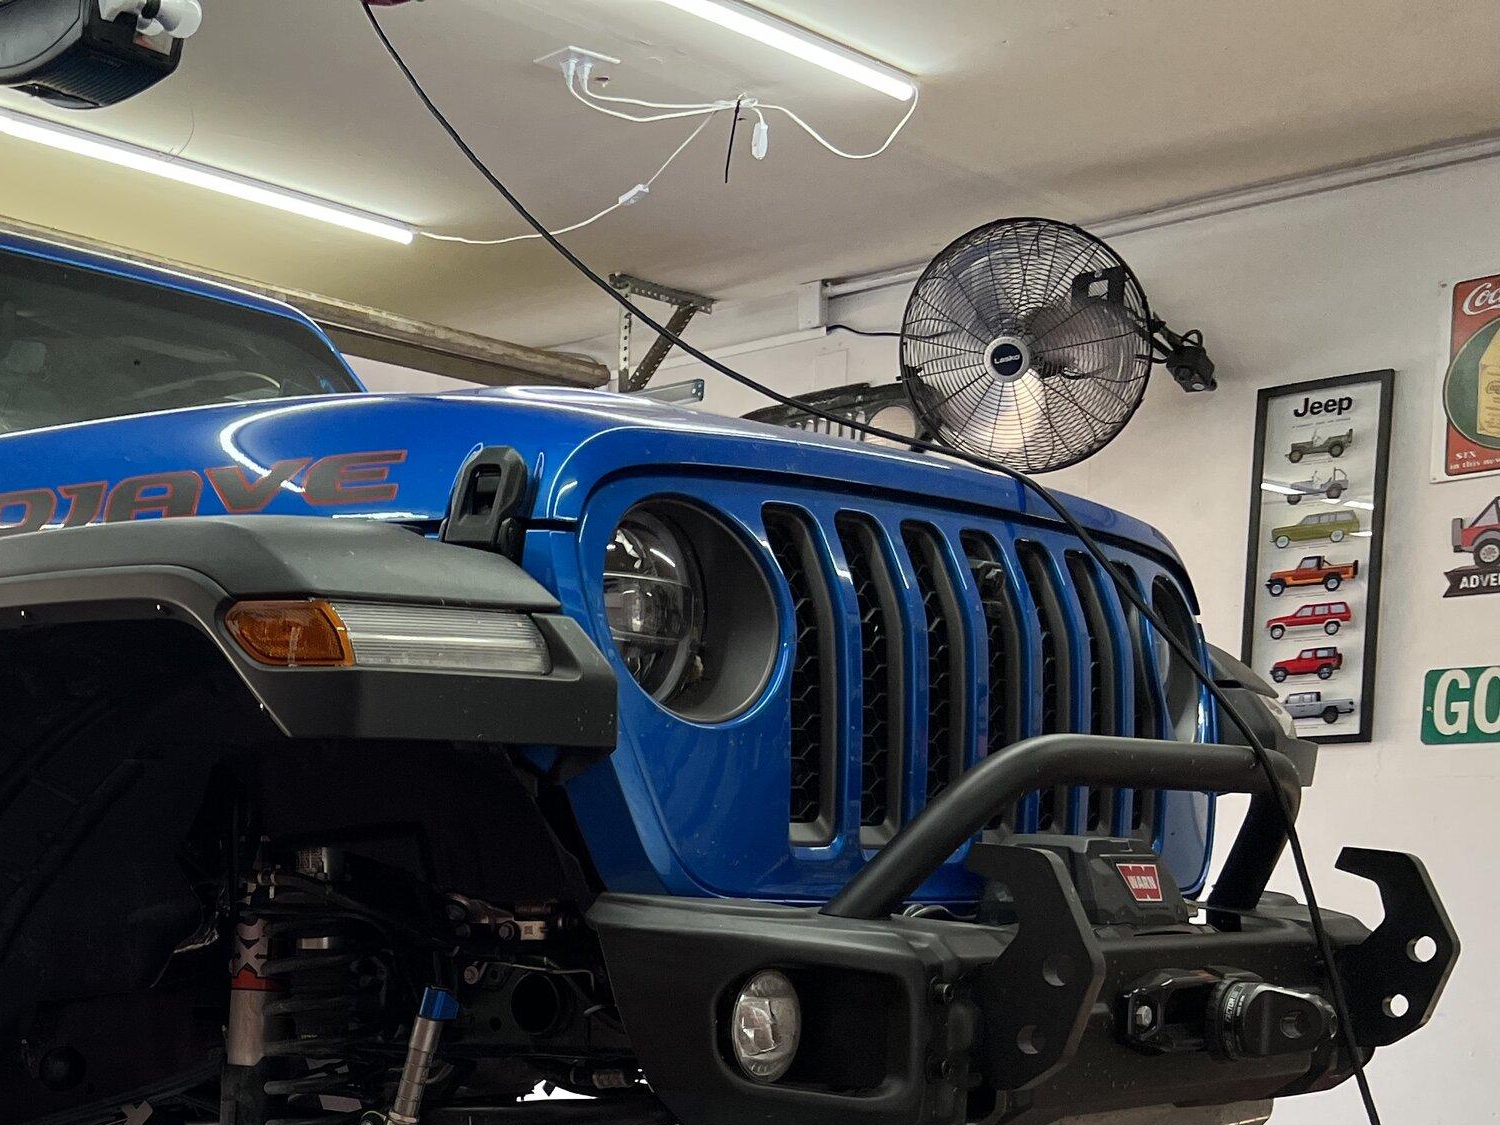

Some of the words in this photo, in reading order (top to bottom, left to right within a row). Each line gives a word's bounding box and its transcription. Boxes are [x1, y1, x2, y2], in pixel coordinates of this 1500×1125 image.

[1293, 396, 1353, 418] Jeep
[1460, 573, 1500, 589] ADVE
[1127, 875, 1157, 890] WARN
